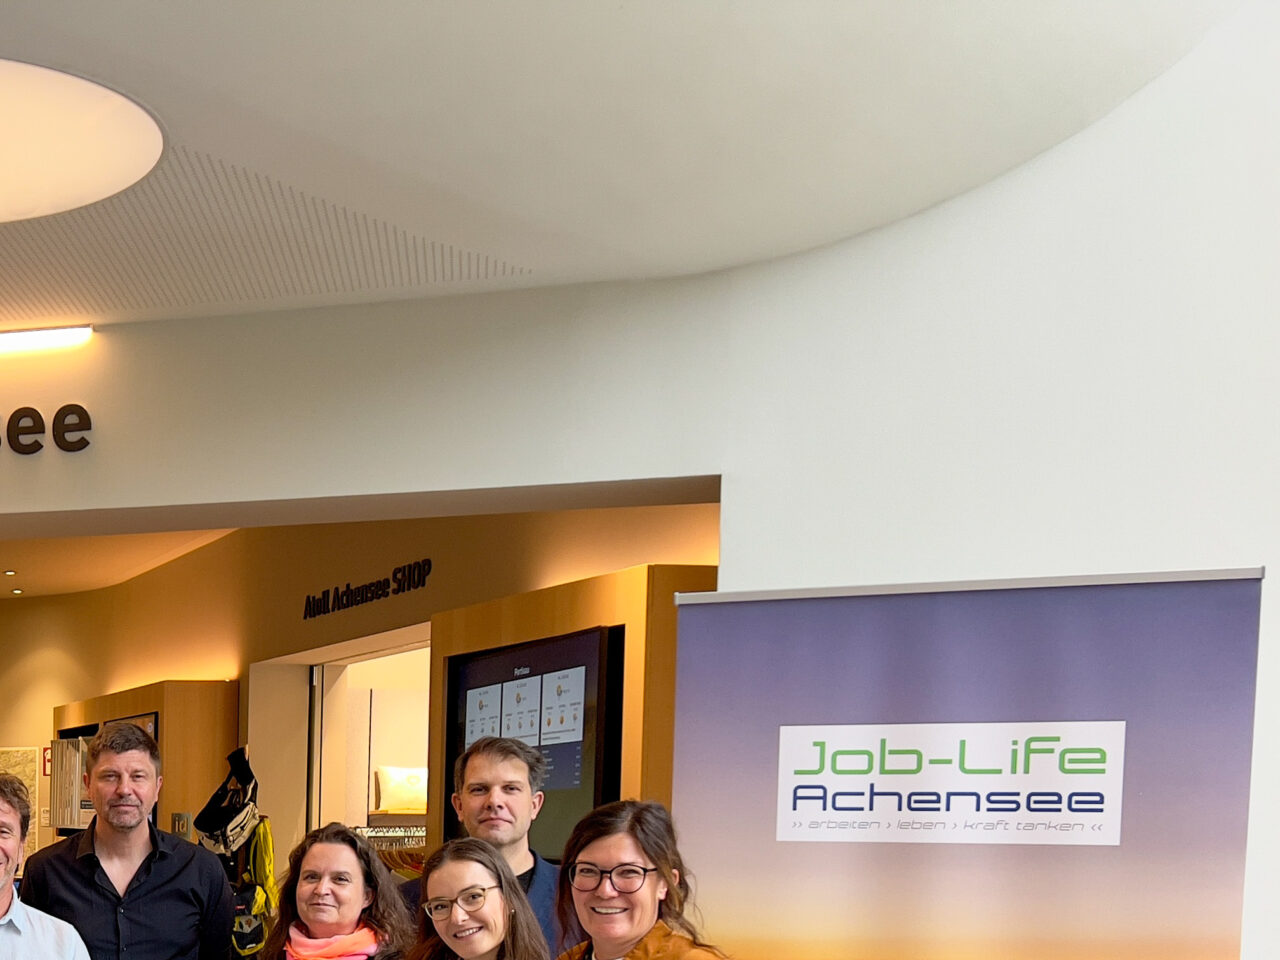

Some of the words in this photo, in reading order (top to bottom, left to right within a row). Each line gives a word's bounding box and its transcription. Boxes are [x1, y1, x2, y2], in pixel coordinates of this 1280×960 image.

[331, 578, 391, 612] Achensee
[391, 558, 432, 595] SHOP
[793, 736, 1108, 776] Job-Life
[792, 782, 1106, 814] Achensee
[808, 819, 881, 830] arbeiten
[897, 819, 946, 831] leben
[963, 819, 1010, 831] kraft
[1016, 820, 1085, 832] tanken
